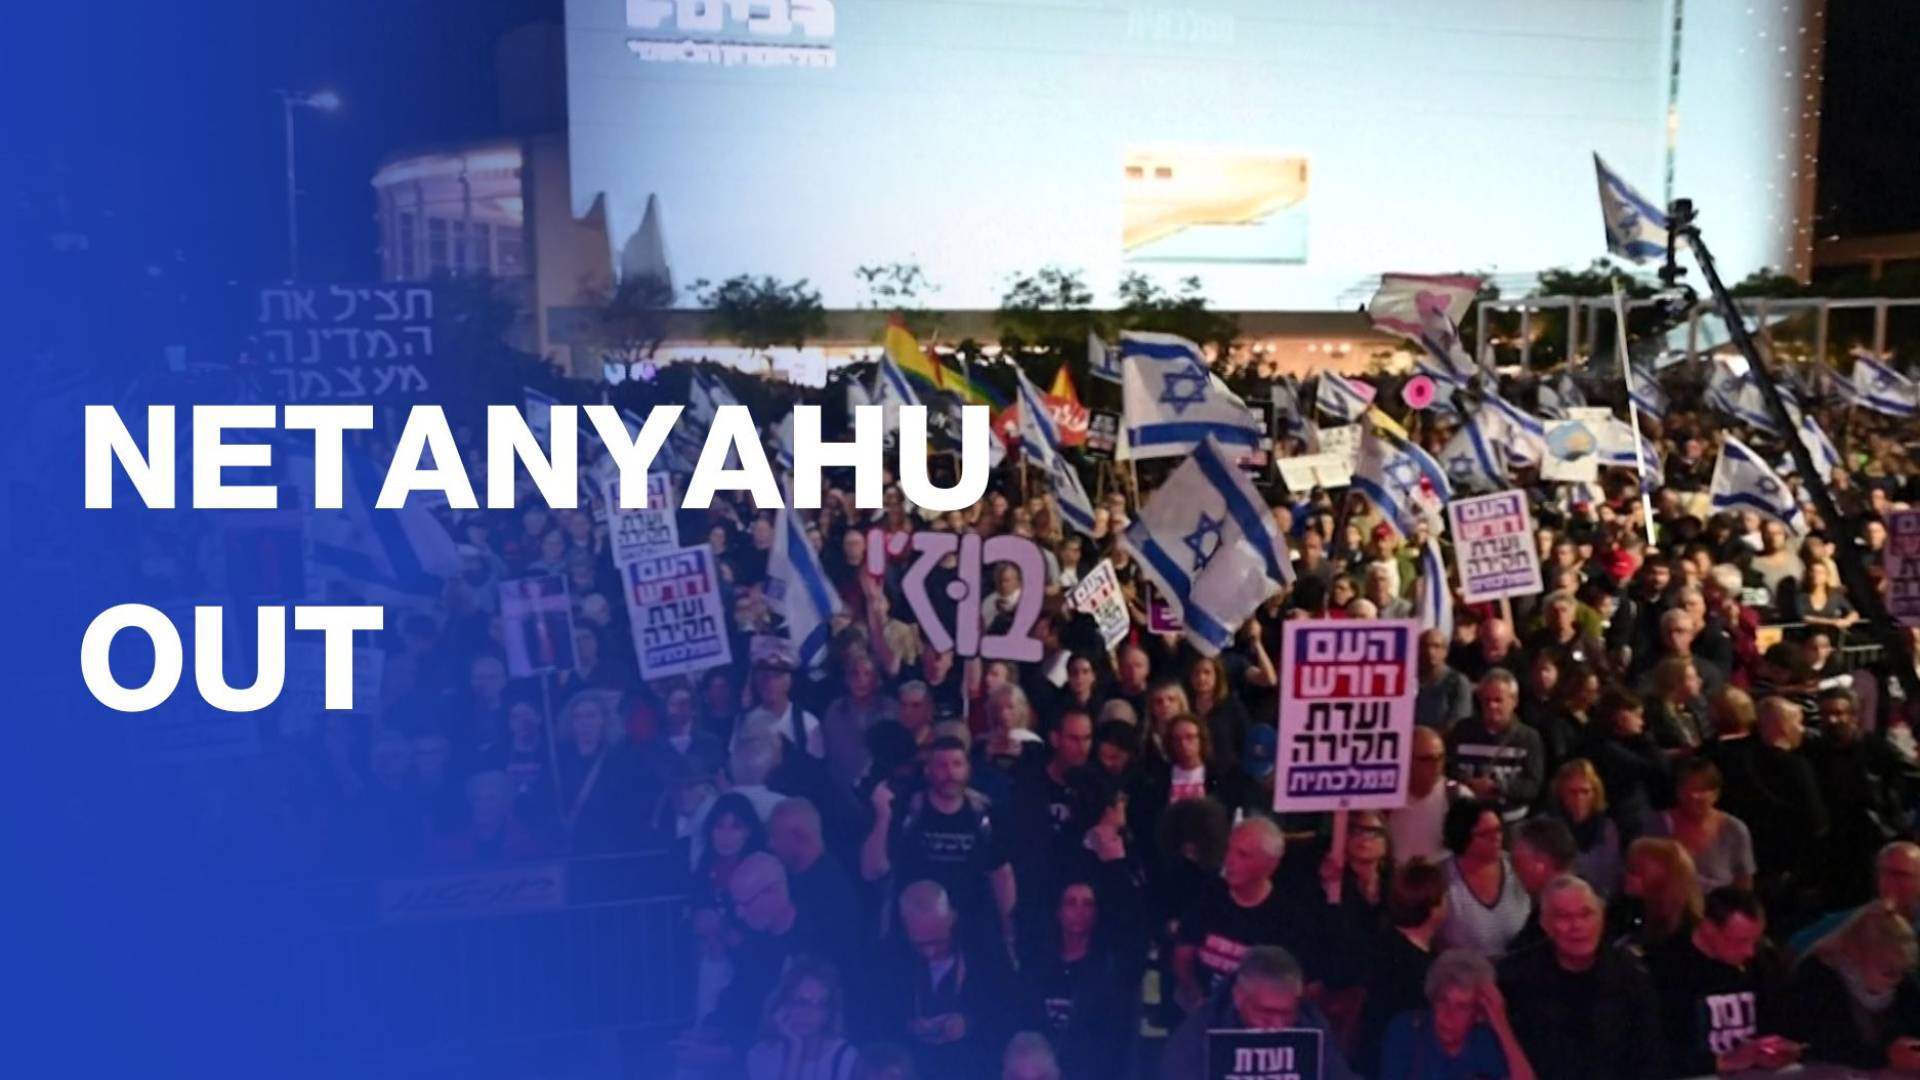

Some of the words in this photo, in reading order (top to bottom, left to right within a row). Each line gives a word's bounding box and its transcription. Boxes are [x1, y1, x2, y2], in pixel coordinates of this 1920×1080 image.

[258, 288, 319, 322] את
[328, 285, 433, 322] תציל
[263, 325, 433, 364] המדינה
[268, 364, 430, 402] מעצמך
[636, 553, 700, 582] העם
[649, 597, 705, 625] ועדת
[643, 615, 717, 647] חקירה
[1306, 630, 1397, 663] העם
[1300, 664, 1400, 697] דורש
[1305, 702, 1390, 731] ועדת
[1292, 732, 1398, 765] חקירה
[1289, 767, 1396, 793] ממלכתית
[1234, 1046, 1295, 1072] ועדת
